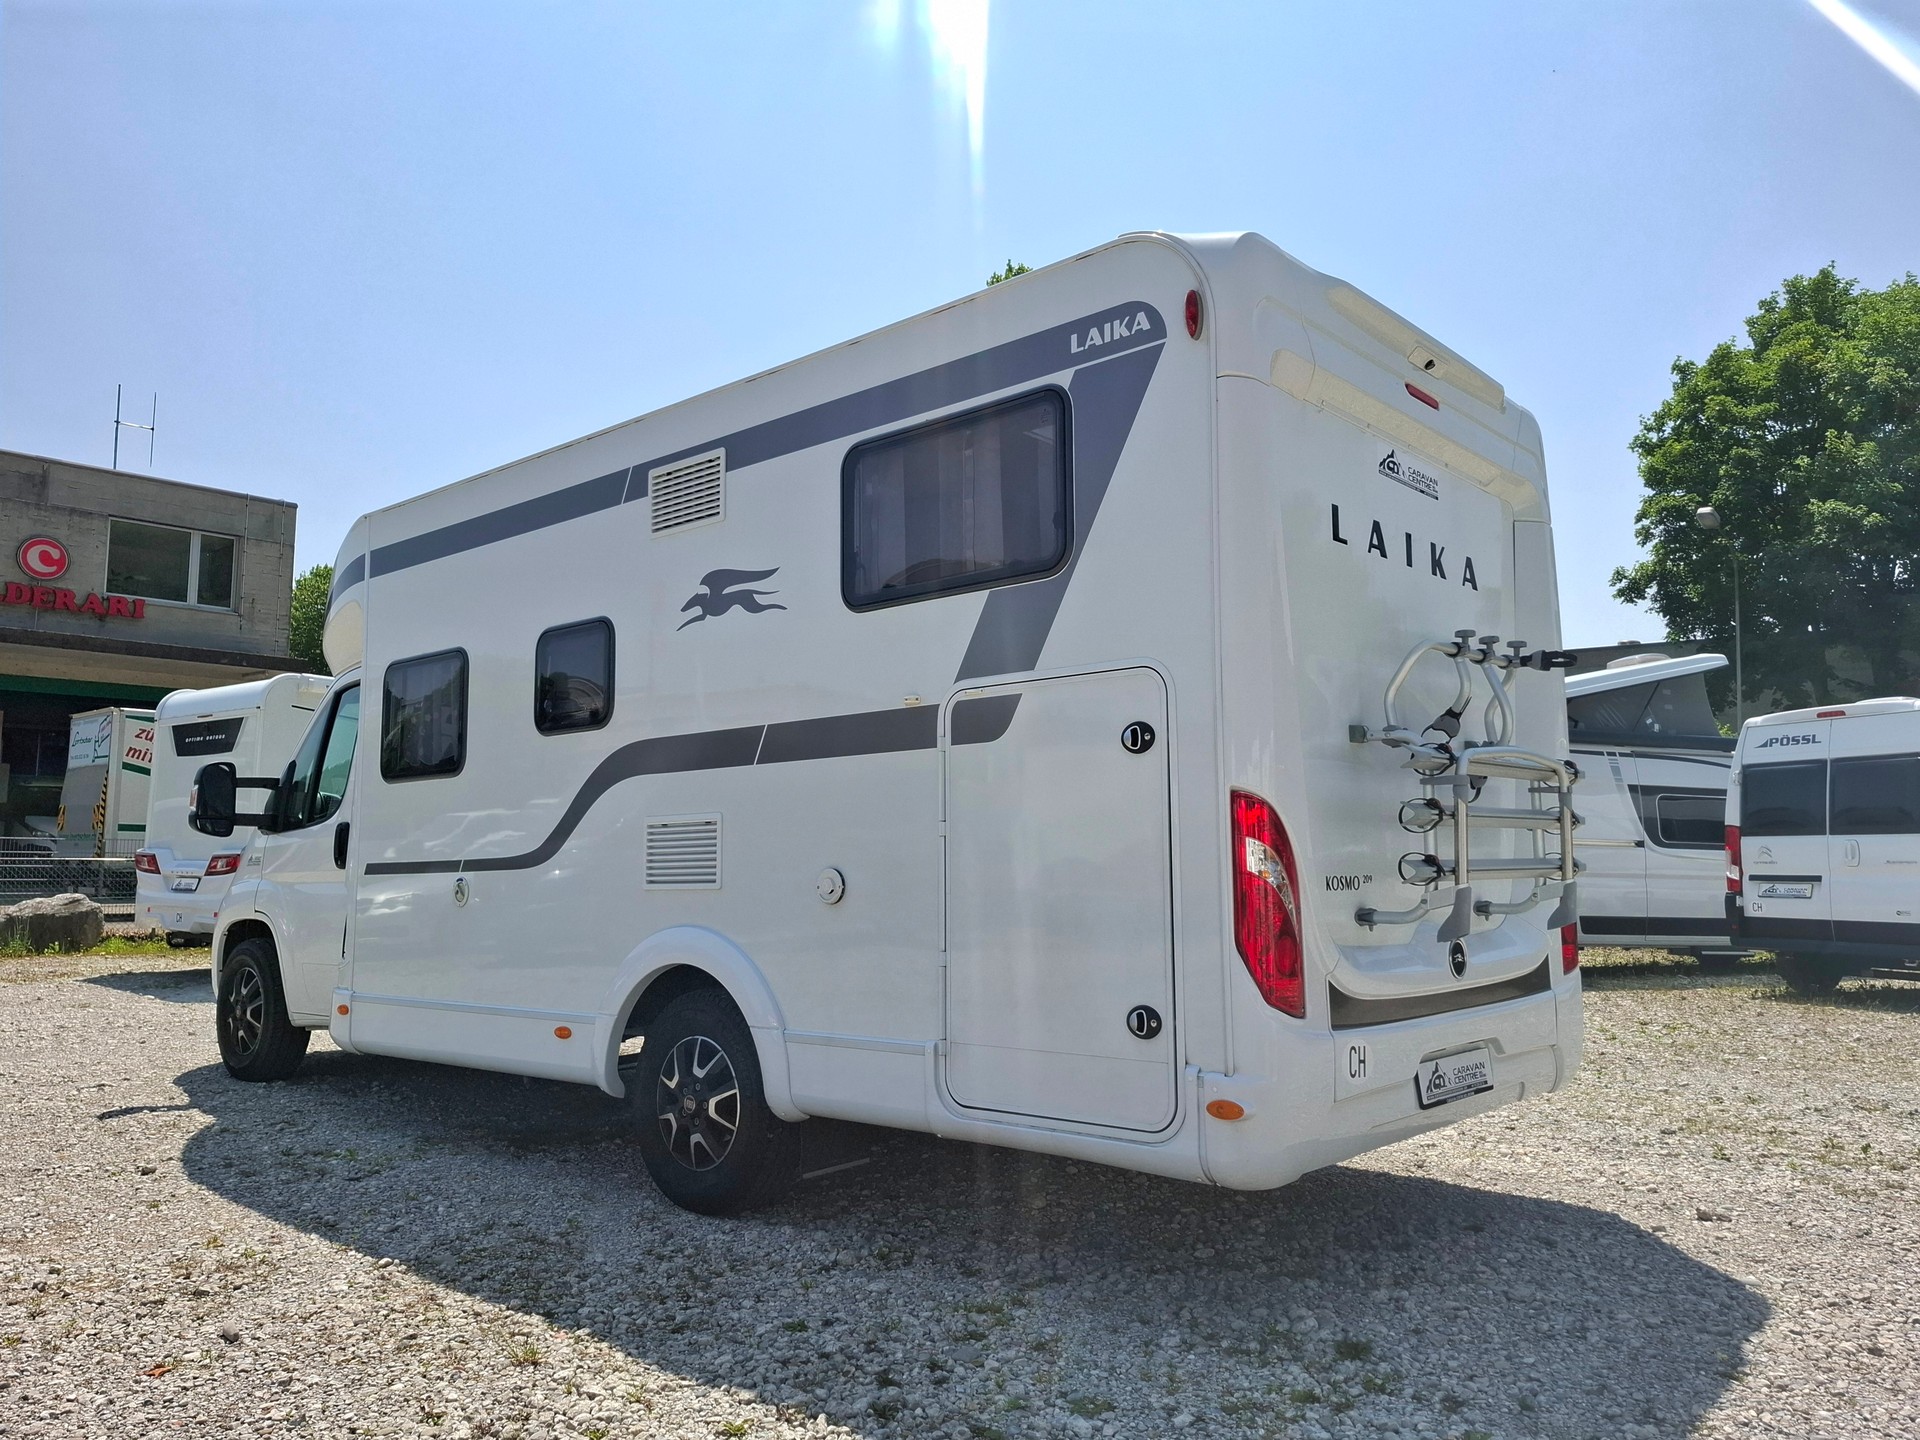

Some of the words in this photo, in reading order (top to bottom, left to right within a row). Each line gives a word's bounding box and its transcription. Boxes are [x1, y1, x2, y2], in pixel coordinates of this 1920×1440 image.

[1070, 311, 1151, 354] LAIKA
[1408, 466, 1438, 487] CARAVAN
[1408, 474, 1432, 491] CENTRE
[1331, 503, 1478, 592] LAIKA
[26, 544, 61, 573] C
[0, 581, 146, 619] DERARI
[1768, 734, 1822, 748] PÖSSL
[1325, 875, 1361, 891] KOSMO
[1362, 874, 1373, 884] 209
[1752, 902, 1763, 913] CH
[1349, 1045, 1367, 1079] CH
[1452, 1061, 1486, 1076] CARAVAN
[1454, 1071, 1480, 1084] CENTRE
